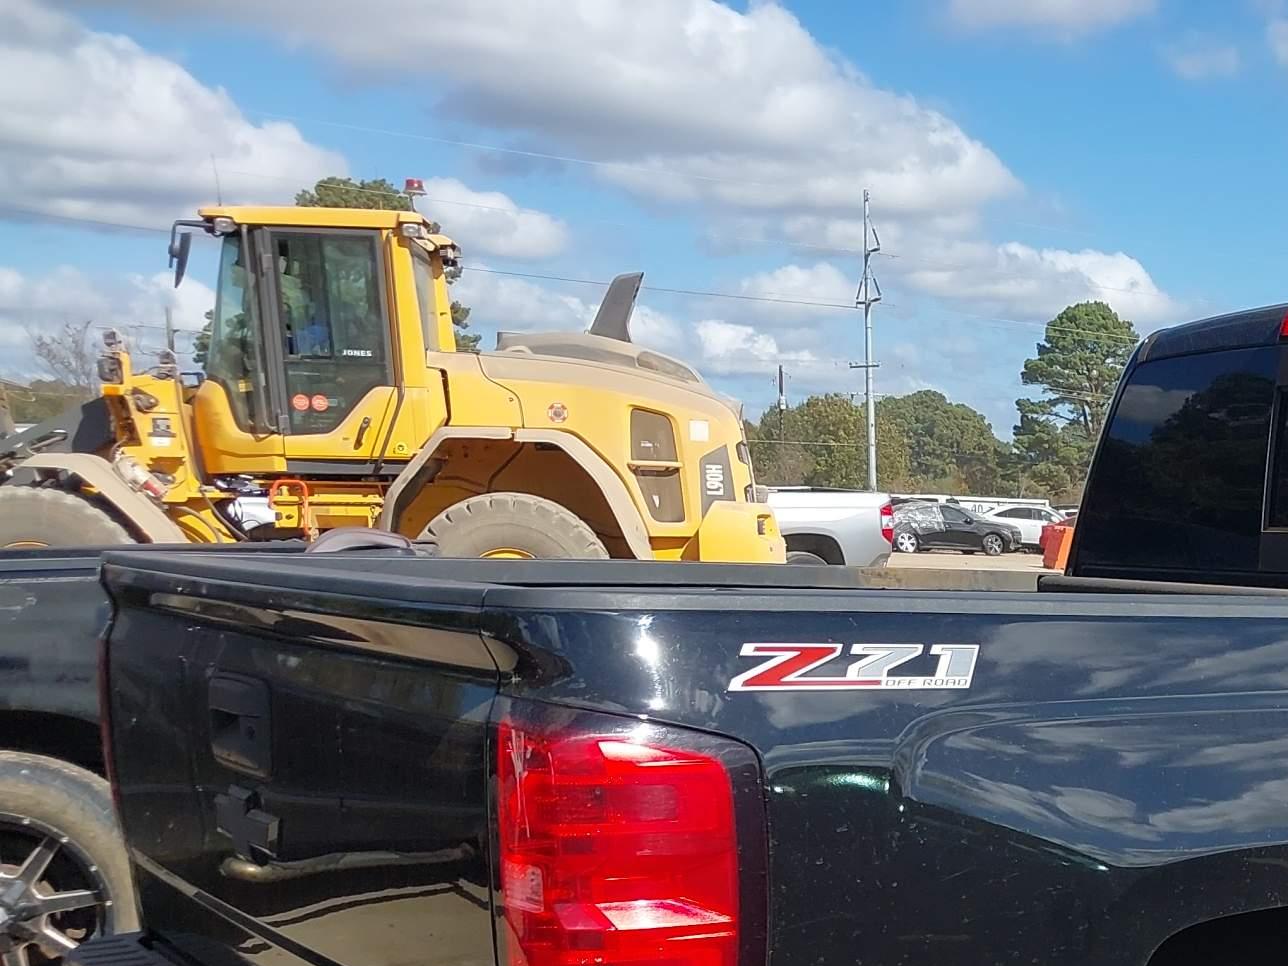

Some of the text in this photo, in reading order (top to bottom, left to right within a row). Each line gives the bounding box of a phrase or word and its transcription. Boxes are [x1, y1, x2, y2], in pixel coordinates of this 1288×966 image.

[342, 349, 373, 357] JONES
[705, 464, 724, 496] L90H
[727, 643, 980, 691] Z71
[885, 679, 968, 687] OFF ROAD
